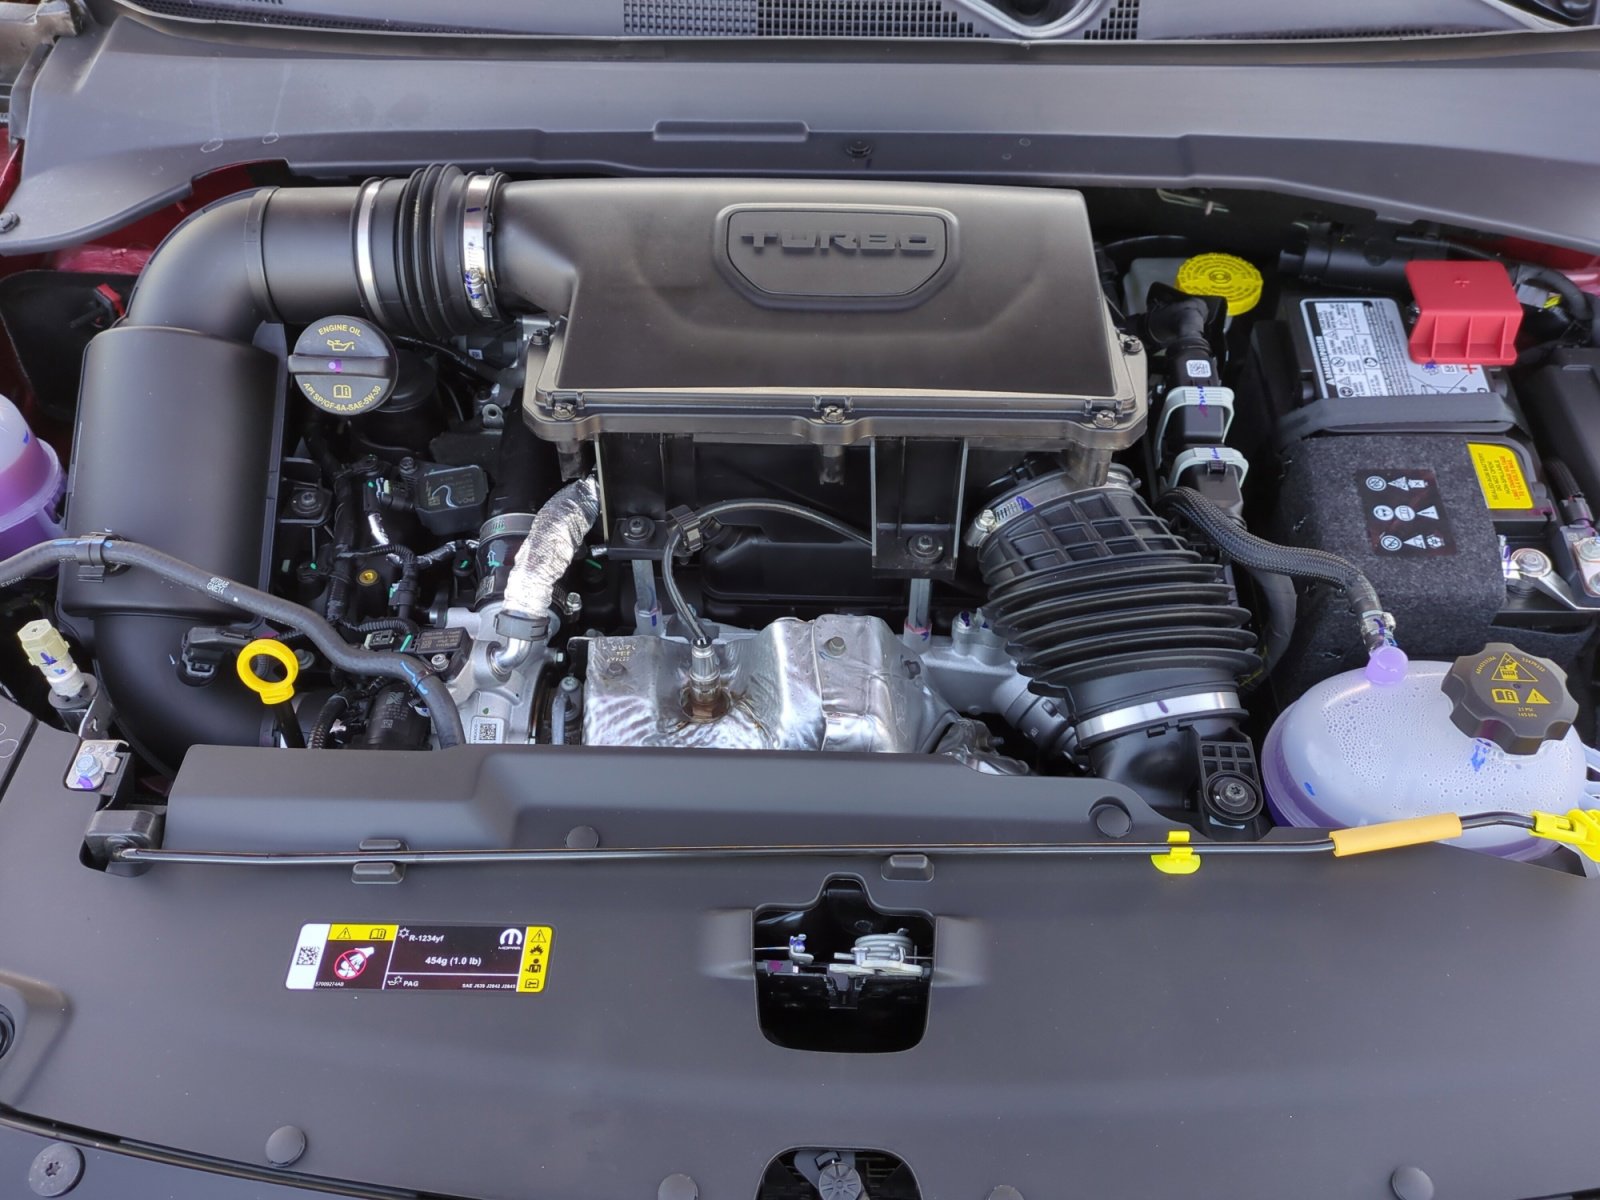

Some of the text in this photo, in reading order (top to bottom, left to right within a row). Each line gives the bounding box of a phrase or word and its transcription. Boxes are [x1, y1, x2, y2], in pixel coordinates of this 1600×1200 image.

[741, 231, 935, 256] TURBO
[318, 324, 361, 336] ENGINE OIL
[303, 383, 315, 395] API
[408, 934, 445, 943] R-1234yf
[424, 956, 482, 966] 454g (1.0 lb)
